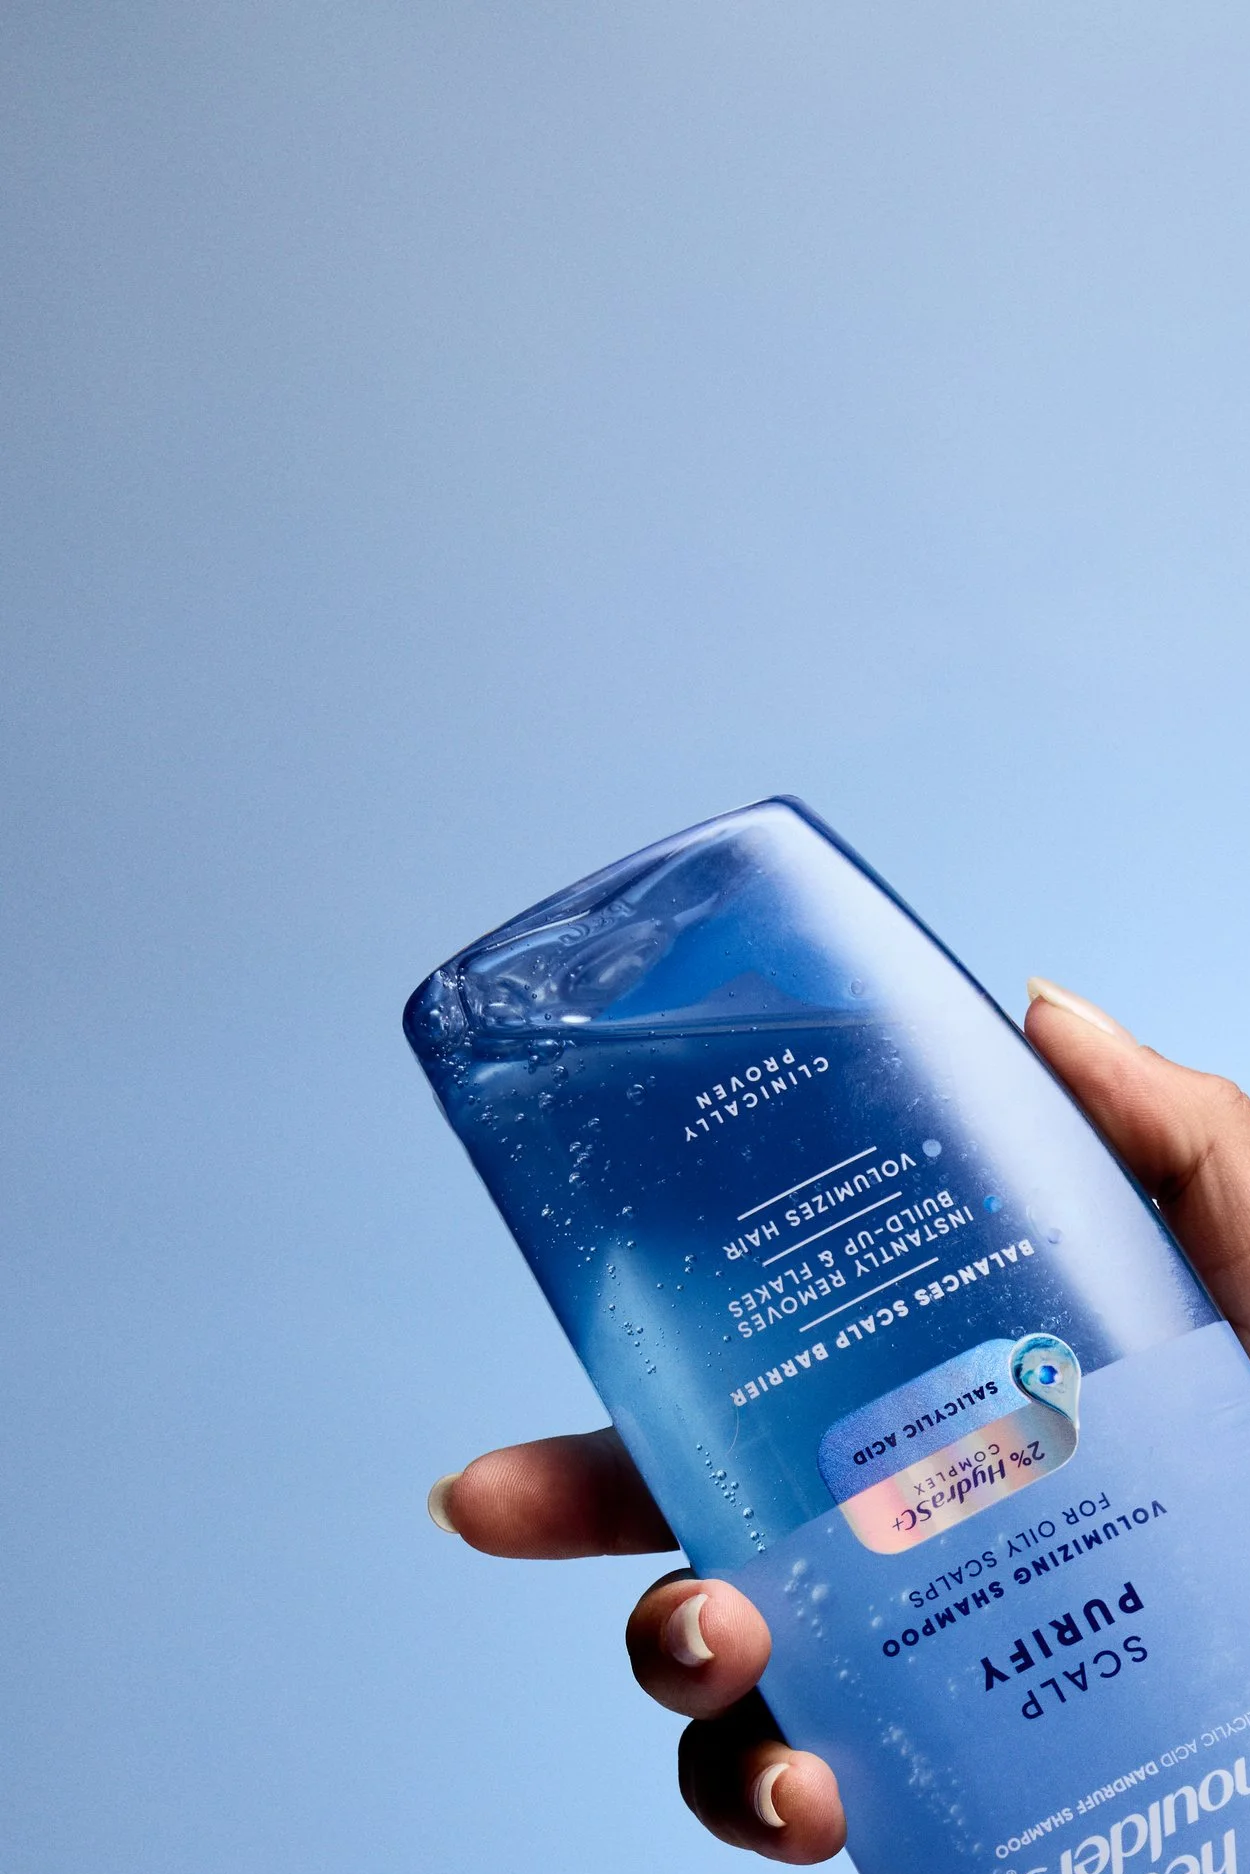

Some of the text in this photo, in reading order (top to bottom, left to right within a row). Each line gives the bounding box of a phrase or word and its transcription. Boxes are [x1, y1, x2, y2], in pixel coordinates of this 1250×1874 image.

[684, 1056, 829, 1142] CLINICALLY
[695, 1048, 796, 1110] PROVEN
[722, 1153, 917, 1260] VOLUMIZES HAIR
[728, 1190, 954, 1318] BUILD-UP & FLAKES
[737, 1205, 974, 1338] INSTANTLY REMOVES
[730, 1239, 1034, 1407] BALANCES SCALP BARRIER
[853, 1381, 999, 1466] SALICYLIC ACID
[1009, 1440, 1046, 1468] 2%
[913, 1443, 1000, 1496] COMPLEX
[882, 1500, 1168, 1658] VOLUMIZING SHAMPOO
[908, 1492, 1111, 1609] FOR OILY SCALPS
[980, 1581, 1145, 1692] PURIFY
[1021, 1635, 1148, 1720] SCALP
[1076, 1760, 1160, 1815] DANDRUFF
[1159, 1738, 1198, 1768] ACID
[995, 1807, 1074, 1859] SHAMPOO
